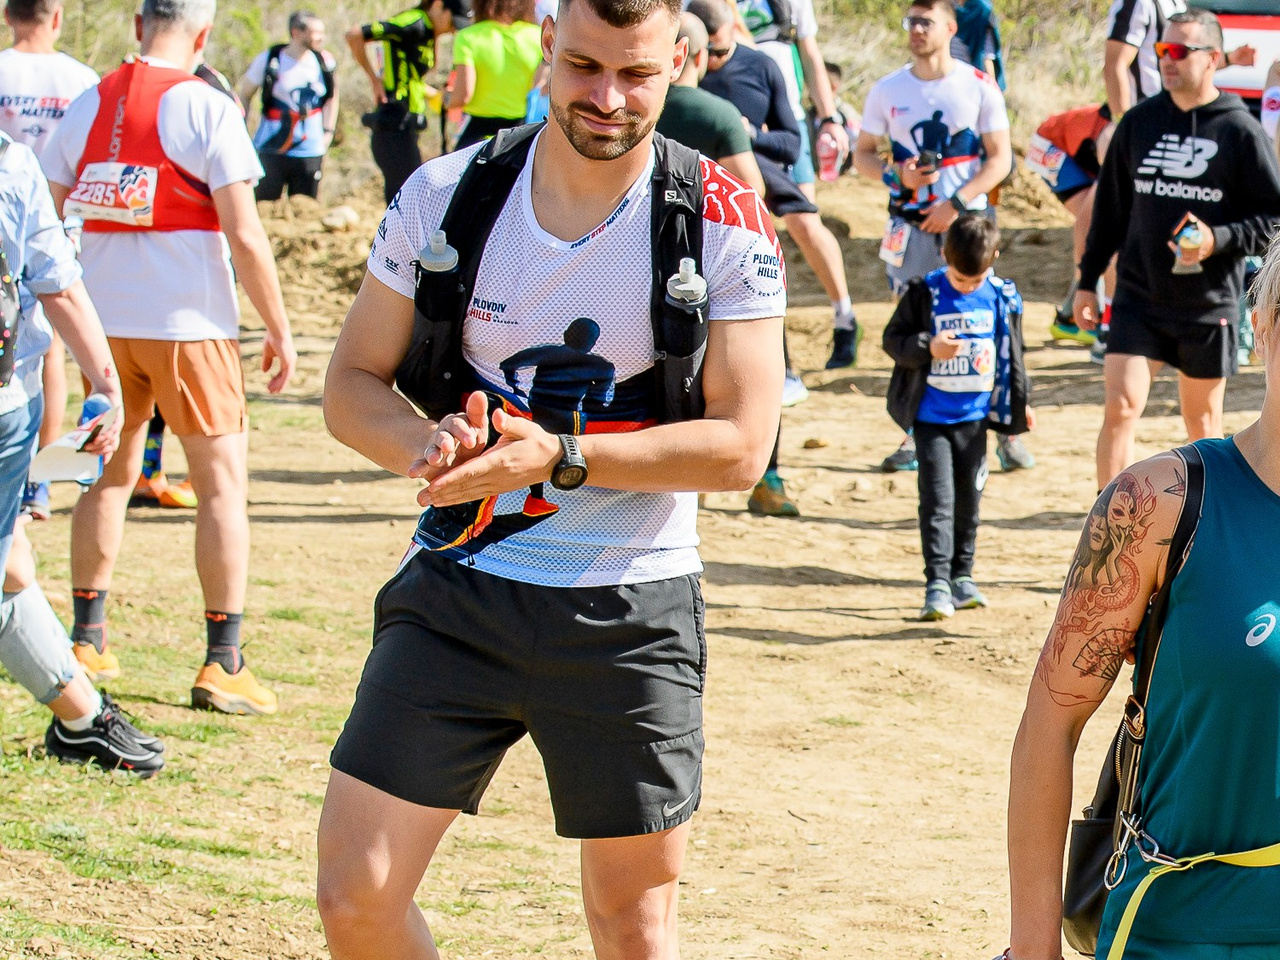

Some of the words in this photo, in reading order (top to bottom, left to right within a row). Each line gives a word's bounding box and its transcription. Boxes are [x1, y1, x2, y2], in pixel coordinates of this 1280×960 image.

[69, 183, 116, 206] 2285
[1155, 178, 1223, 202] balance
[591, 223, 607, 239] STEP
[606, 198, 630, 227] MATTERS
[757, 266, 778, 280] HILLS
[472, 297, 507, 313] PLOVDIV
[469, 308, 492, 322] HILLS
